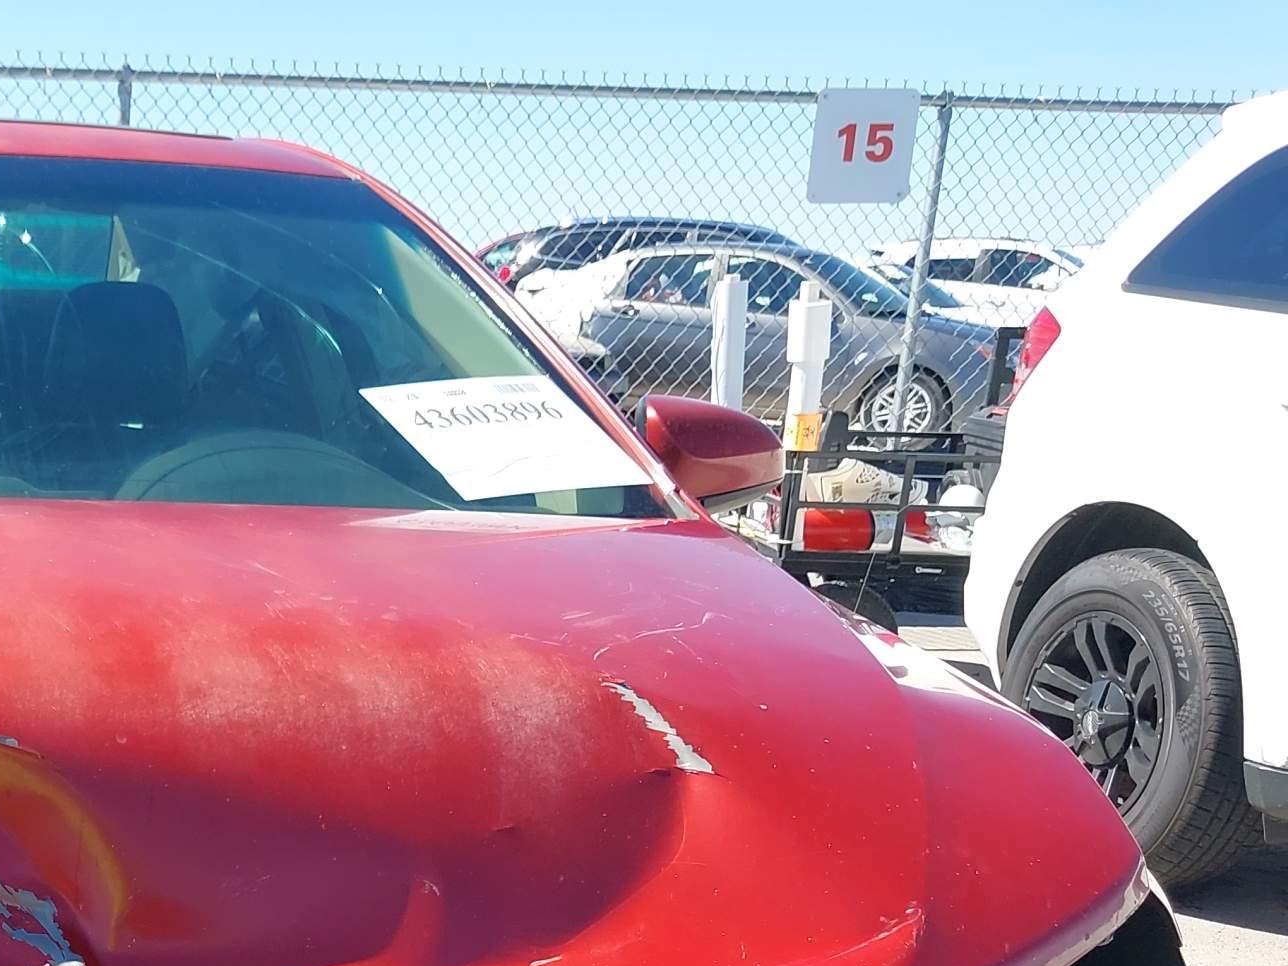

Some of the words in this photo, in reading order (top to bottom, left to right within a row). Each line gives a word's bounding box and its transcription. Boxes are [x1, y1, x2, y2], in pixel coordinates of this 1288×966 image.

[837, 123, 895, 163] 15
[414, 400, 564, 429] 43603896
[1141, 590, 1190, 682] 235/65R17
